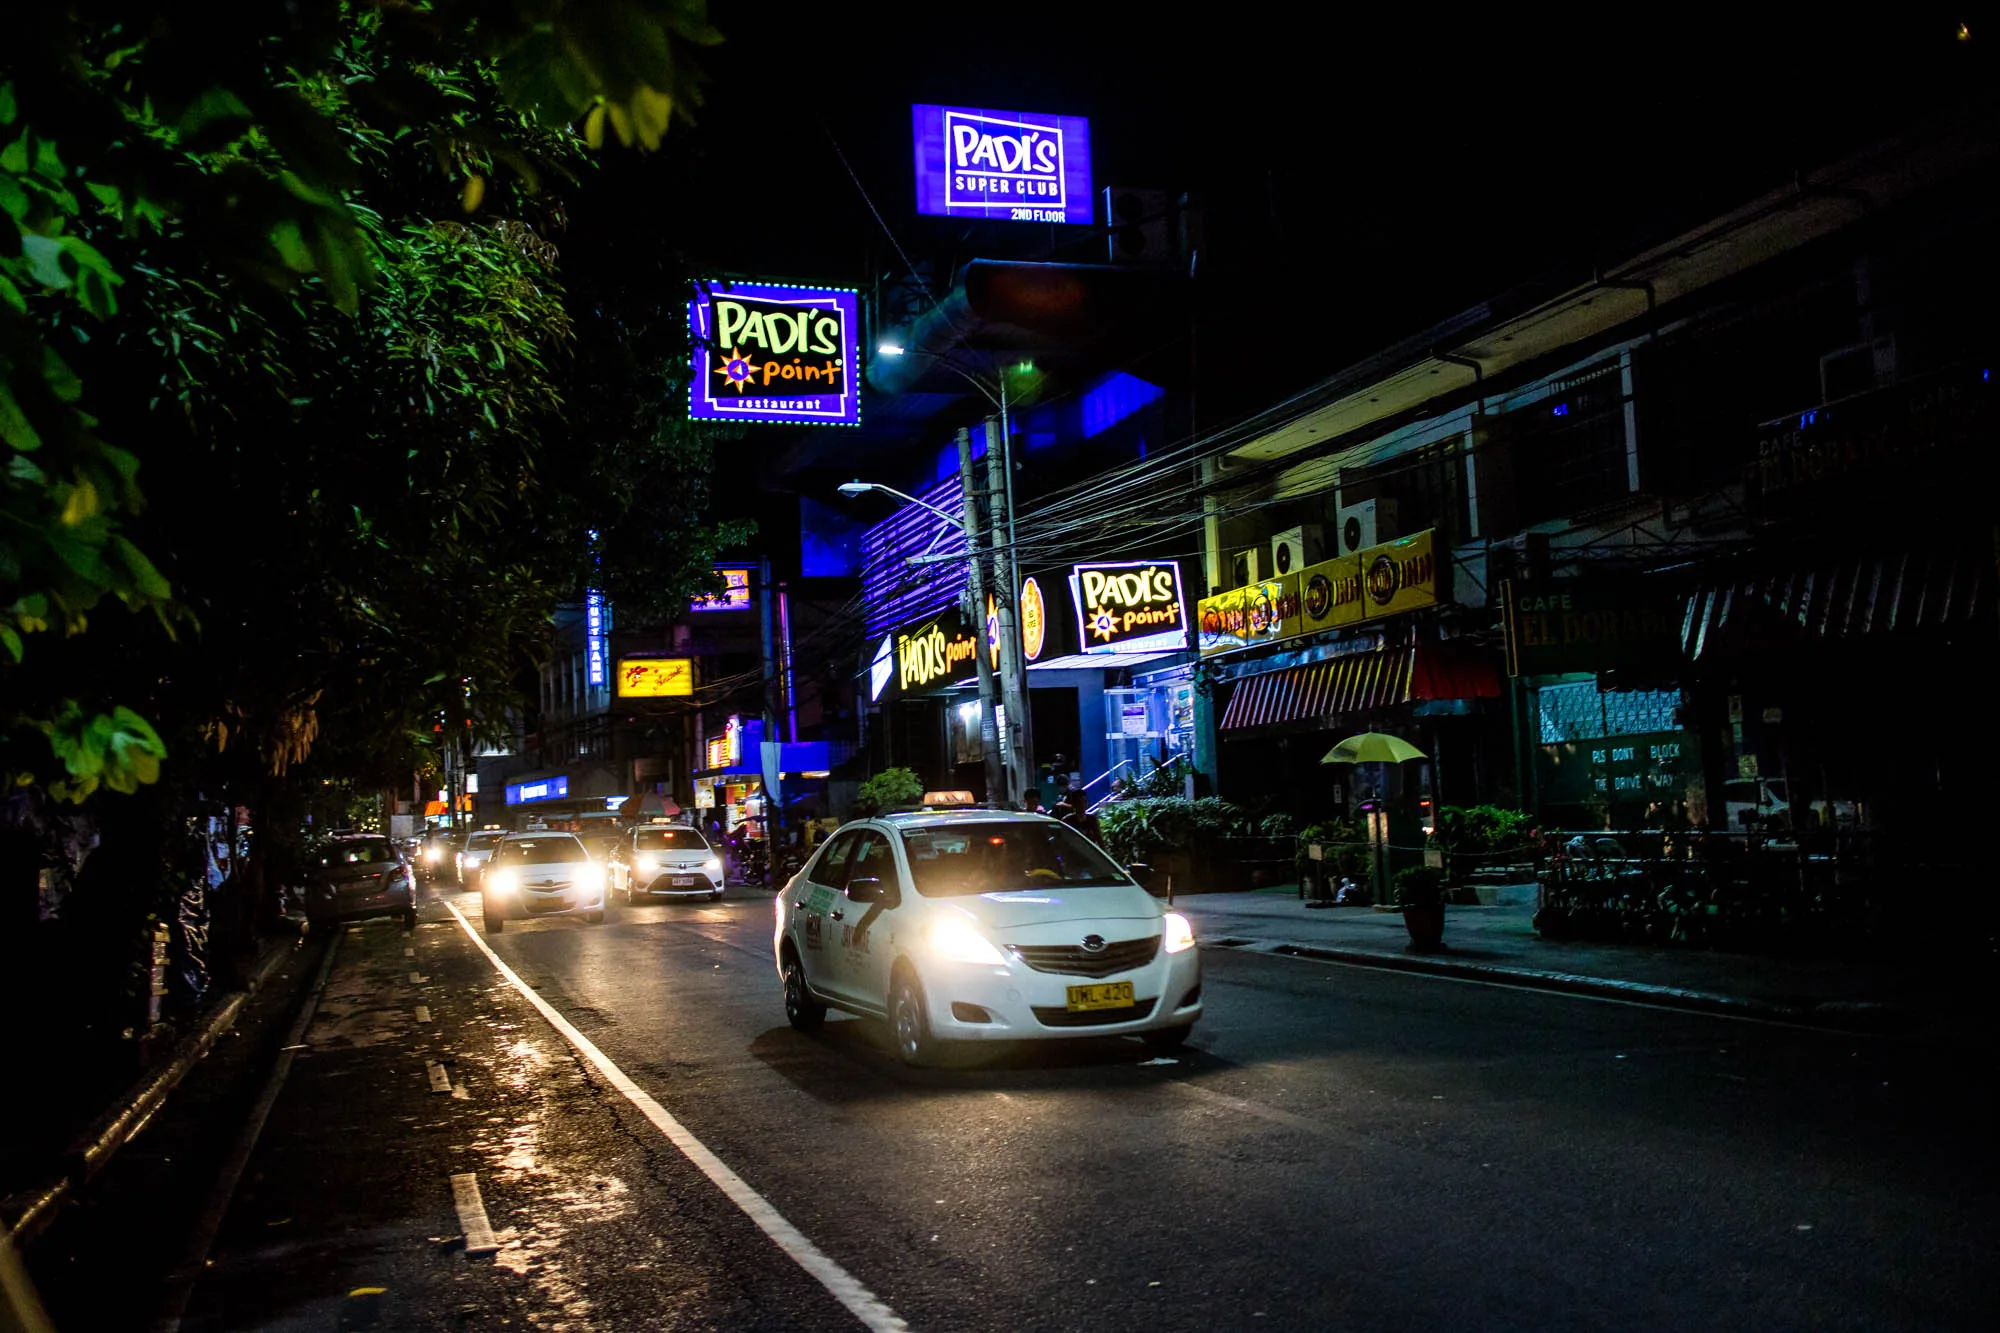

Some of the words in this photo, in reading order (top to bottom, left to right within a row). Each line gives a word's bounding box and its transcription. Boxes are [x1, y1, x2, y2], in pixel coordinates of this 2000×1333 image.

[953, 125, 1057, 173] PADI'S
[955, 176, 1010, 194] SUPER
[1016, 180, 1058, 196] CLUB
[1011, 207, 1032, 221] 2ND
[1034, 209, 1066, 223] FLOOR
[716, 301, 839, 355] PADI'S
[763, 357, 842, 387] point
[738, 398, 821, 410] restaurant
[1082, 566, 1172, 609] PADI'S
[1519, 594, 1573, 612] CAFE
[1123, 604, 1180, 632] point
[898, 624, 946, 690] PADI'S
[1649, 743, 1681, 759] BLOCK
[1614, 775, 1642, 791] DRIVE
[1103, 984, 1132, 1000] 420
